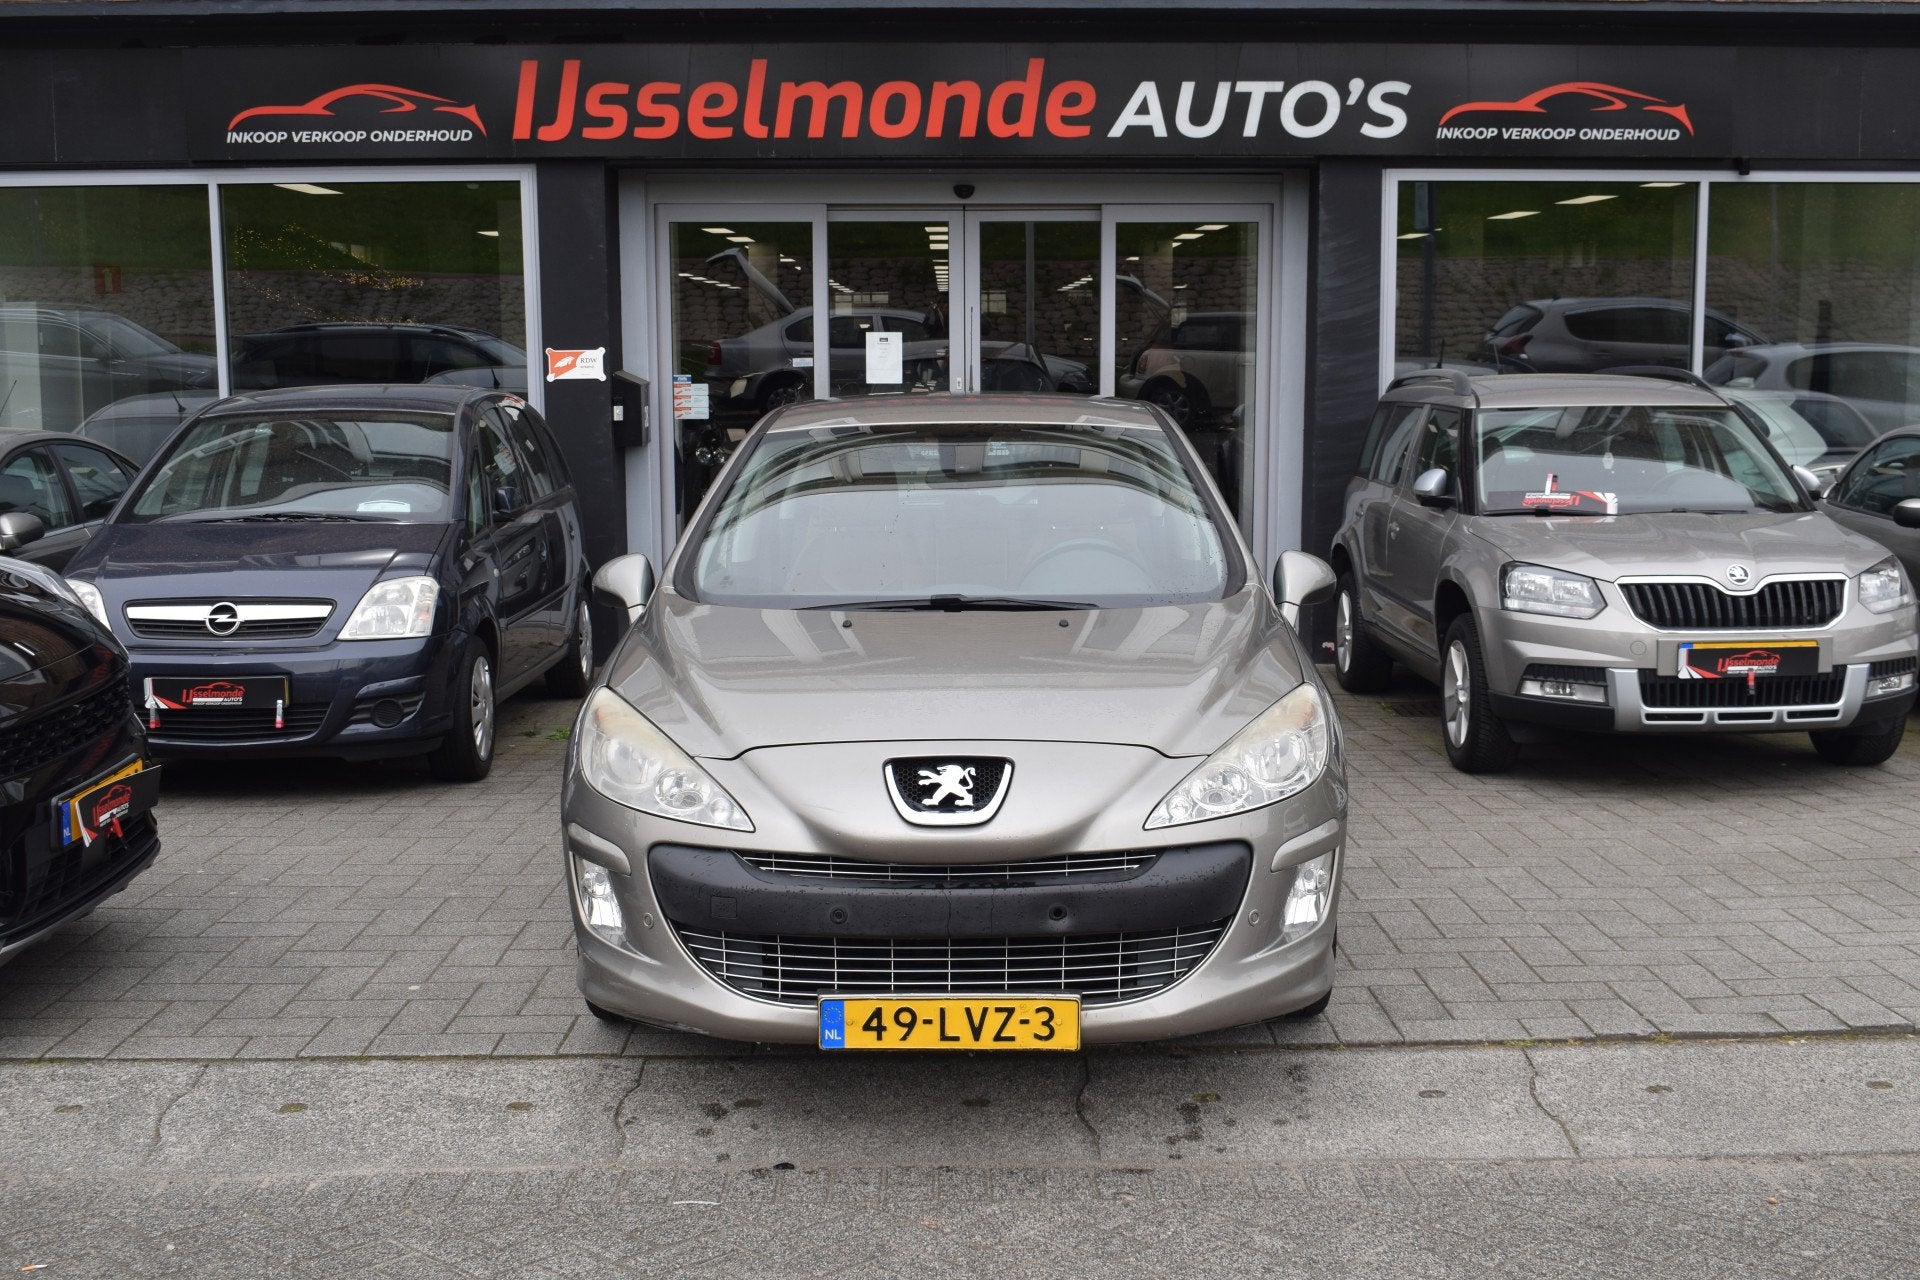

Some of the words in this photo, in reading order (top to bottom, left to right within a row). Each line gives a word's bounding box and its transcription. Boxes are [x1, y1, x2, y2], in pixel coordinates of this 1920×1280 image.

[511, 58, 1097, 142] IJsselmonde
[1107, 77, 1412, 139] AUTO'S
[226, 131, 288, 144] INKOOP
[291, 130, 367, 143] VERKOOP
[370, 129, 473, 142] ONDERHOUD
[1436, 127, 1499, 140] INKOOP
[1501, 127, 1577, 140] VERKOOP
[1579, 128, 1681, 141] ONDERHOUD
[1717, 658, 1779, 672] IJsselmonde
[182, 689, 243, 703] IJsselmonde
[63, 828, 71, 838] NL
[825, 1030, 842, 1040] NL
[862, 1006, 1055, 1042] 49-LVZ-3
